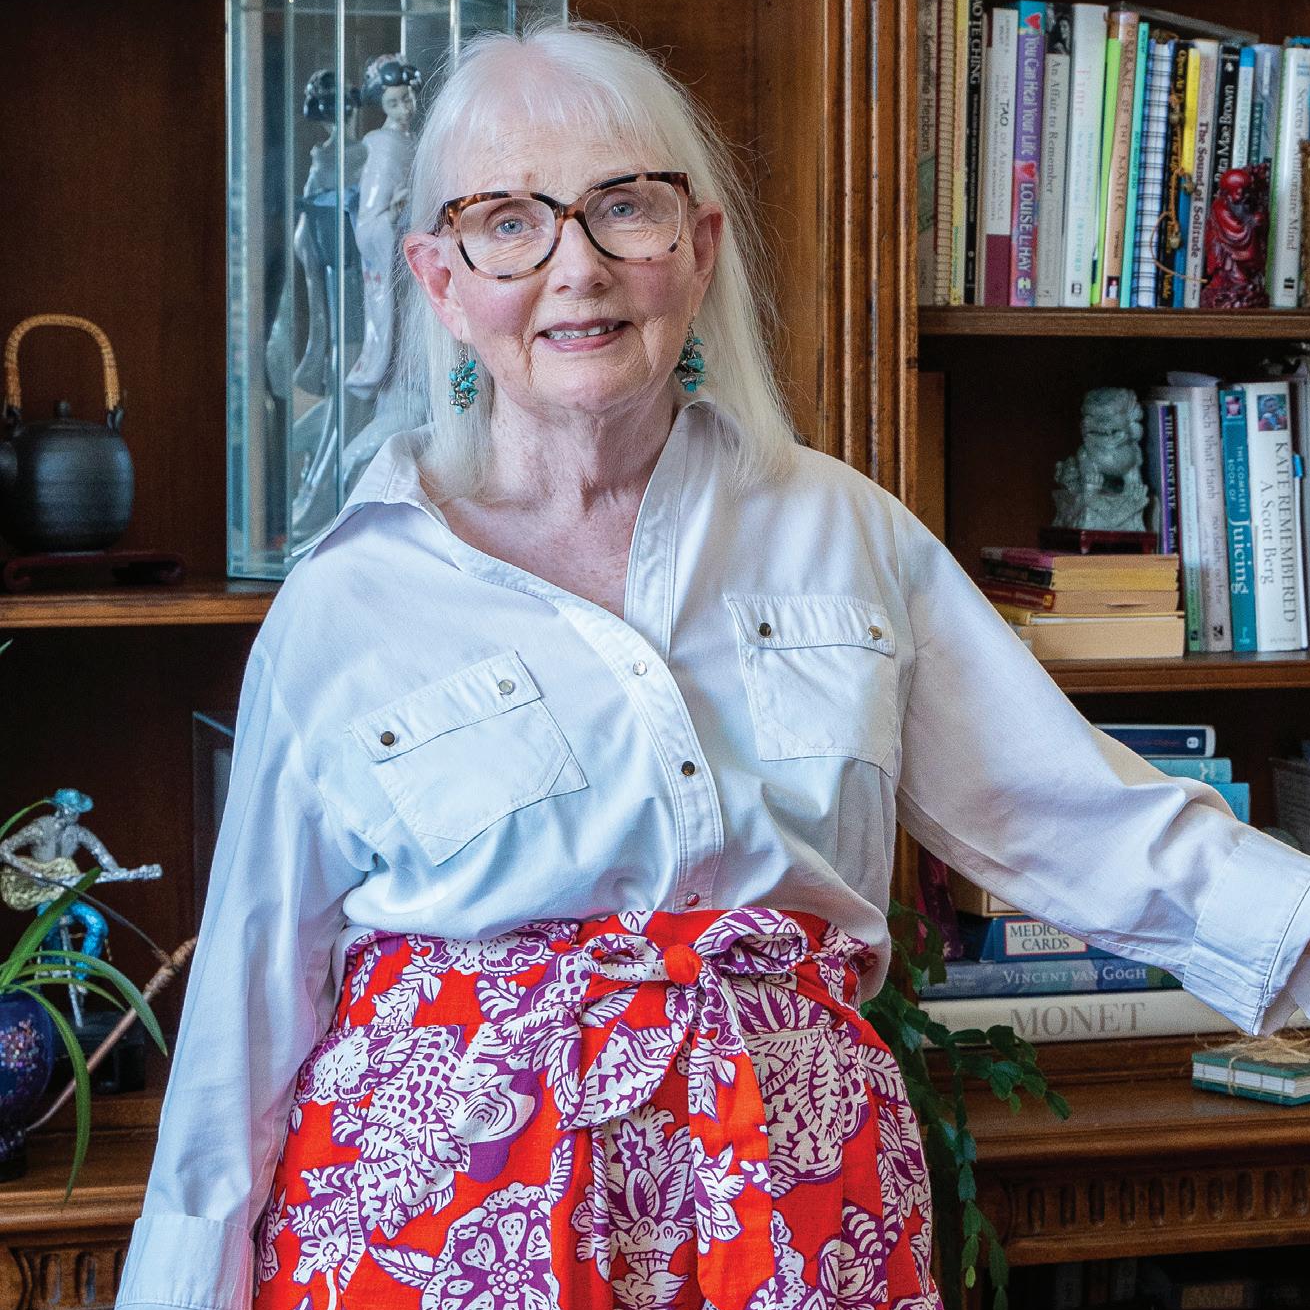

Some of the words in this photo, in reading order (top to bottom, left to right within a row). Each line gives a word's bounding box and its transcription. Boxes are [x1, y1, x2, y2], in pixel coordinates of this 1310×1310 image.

[1023, 35, 1040, 55] You
[921, 33, 935, 94] Katharine
[970, 38, 982, 85] CHING
[1023, 58, 1040, 79] Can
[1050, 59, 1061, 76] An
[1022, 80, 1039, 105] Heal
[1049, 79, 1061, 113] Affair
[1220, 85, 1234, 125] Brown
[1294, 87, 1309, 128] Secrets
[920, 97, 933, 152] Hepburn
[999, 99, 1010, 127] TAO
[1022, 109, 1038, 133] Your
[1048, 115, 1059, 128] to
[1020, 135, 1037, 156] Life
[1197, 121, 1209, 140] The
[1217, 125, 1231, 156] Mae
[1046, 131, 1059, 193] Remember
[1019, 182, 1036, 231] LOUISE
[1194, 186, 1206, 202] of
[1190, 204, 1205, 259] Solitude
[1287, 217, 1300, 250] Mind
[1017, 246, 1033, 272] HAY
[1202, 396, 1213, 429] Thich
[1204, 434, 1216, 462] Nhat
[1236, 445, 1245, 462] THE
[1227, 458, 1236, 486] BOOK
[1275, 442, 1292, 491] KATE
[1205, 468, 1218, 500] Hanh
[1229, 488, 1237, 502] OF
[1237, 466, 1247, 513] COMPLETE
[1261, 500, 1276, 542] Scott
[1228, 517, 1251, 595] Juicing
[1259, 546, 1277, 586] Berg
[1277, 495, 1297, 623] REMEMBERED
[1021, 937, 1070, 952] CARDS
[1003, 968, 1068, 984] VINCENT
[1071, 968, 1099, 982] VAN
[1102, 965, 1147, 981] GOGH
[1010, 1001, 1147, 1037] MONET
